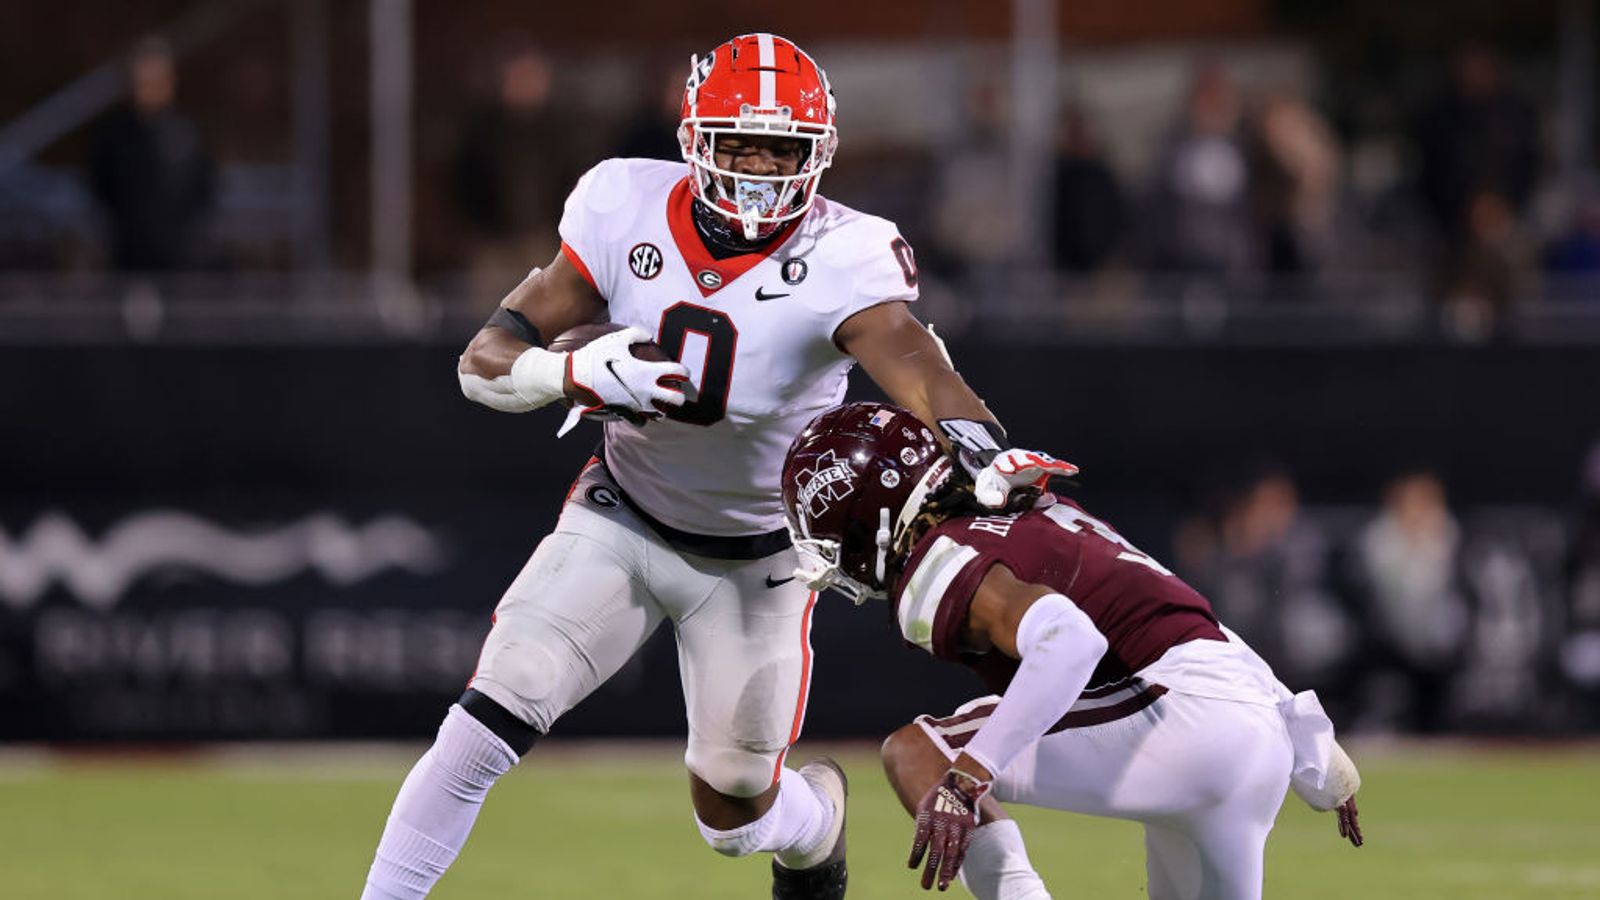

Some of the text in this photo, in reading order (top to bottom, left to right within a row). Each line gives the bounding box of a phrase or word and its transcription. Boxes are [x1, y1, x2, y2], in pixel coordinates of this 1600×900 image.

[631, 245, 661, 278] SEC
[890, 237, 918, 288] 0
[699, 271, 721, 287] G
[658, 301, 738, 426] 0
[805, 467, 847, 499] STATE
[968, 511, 1024, 537] RI
